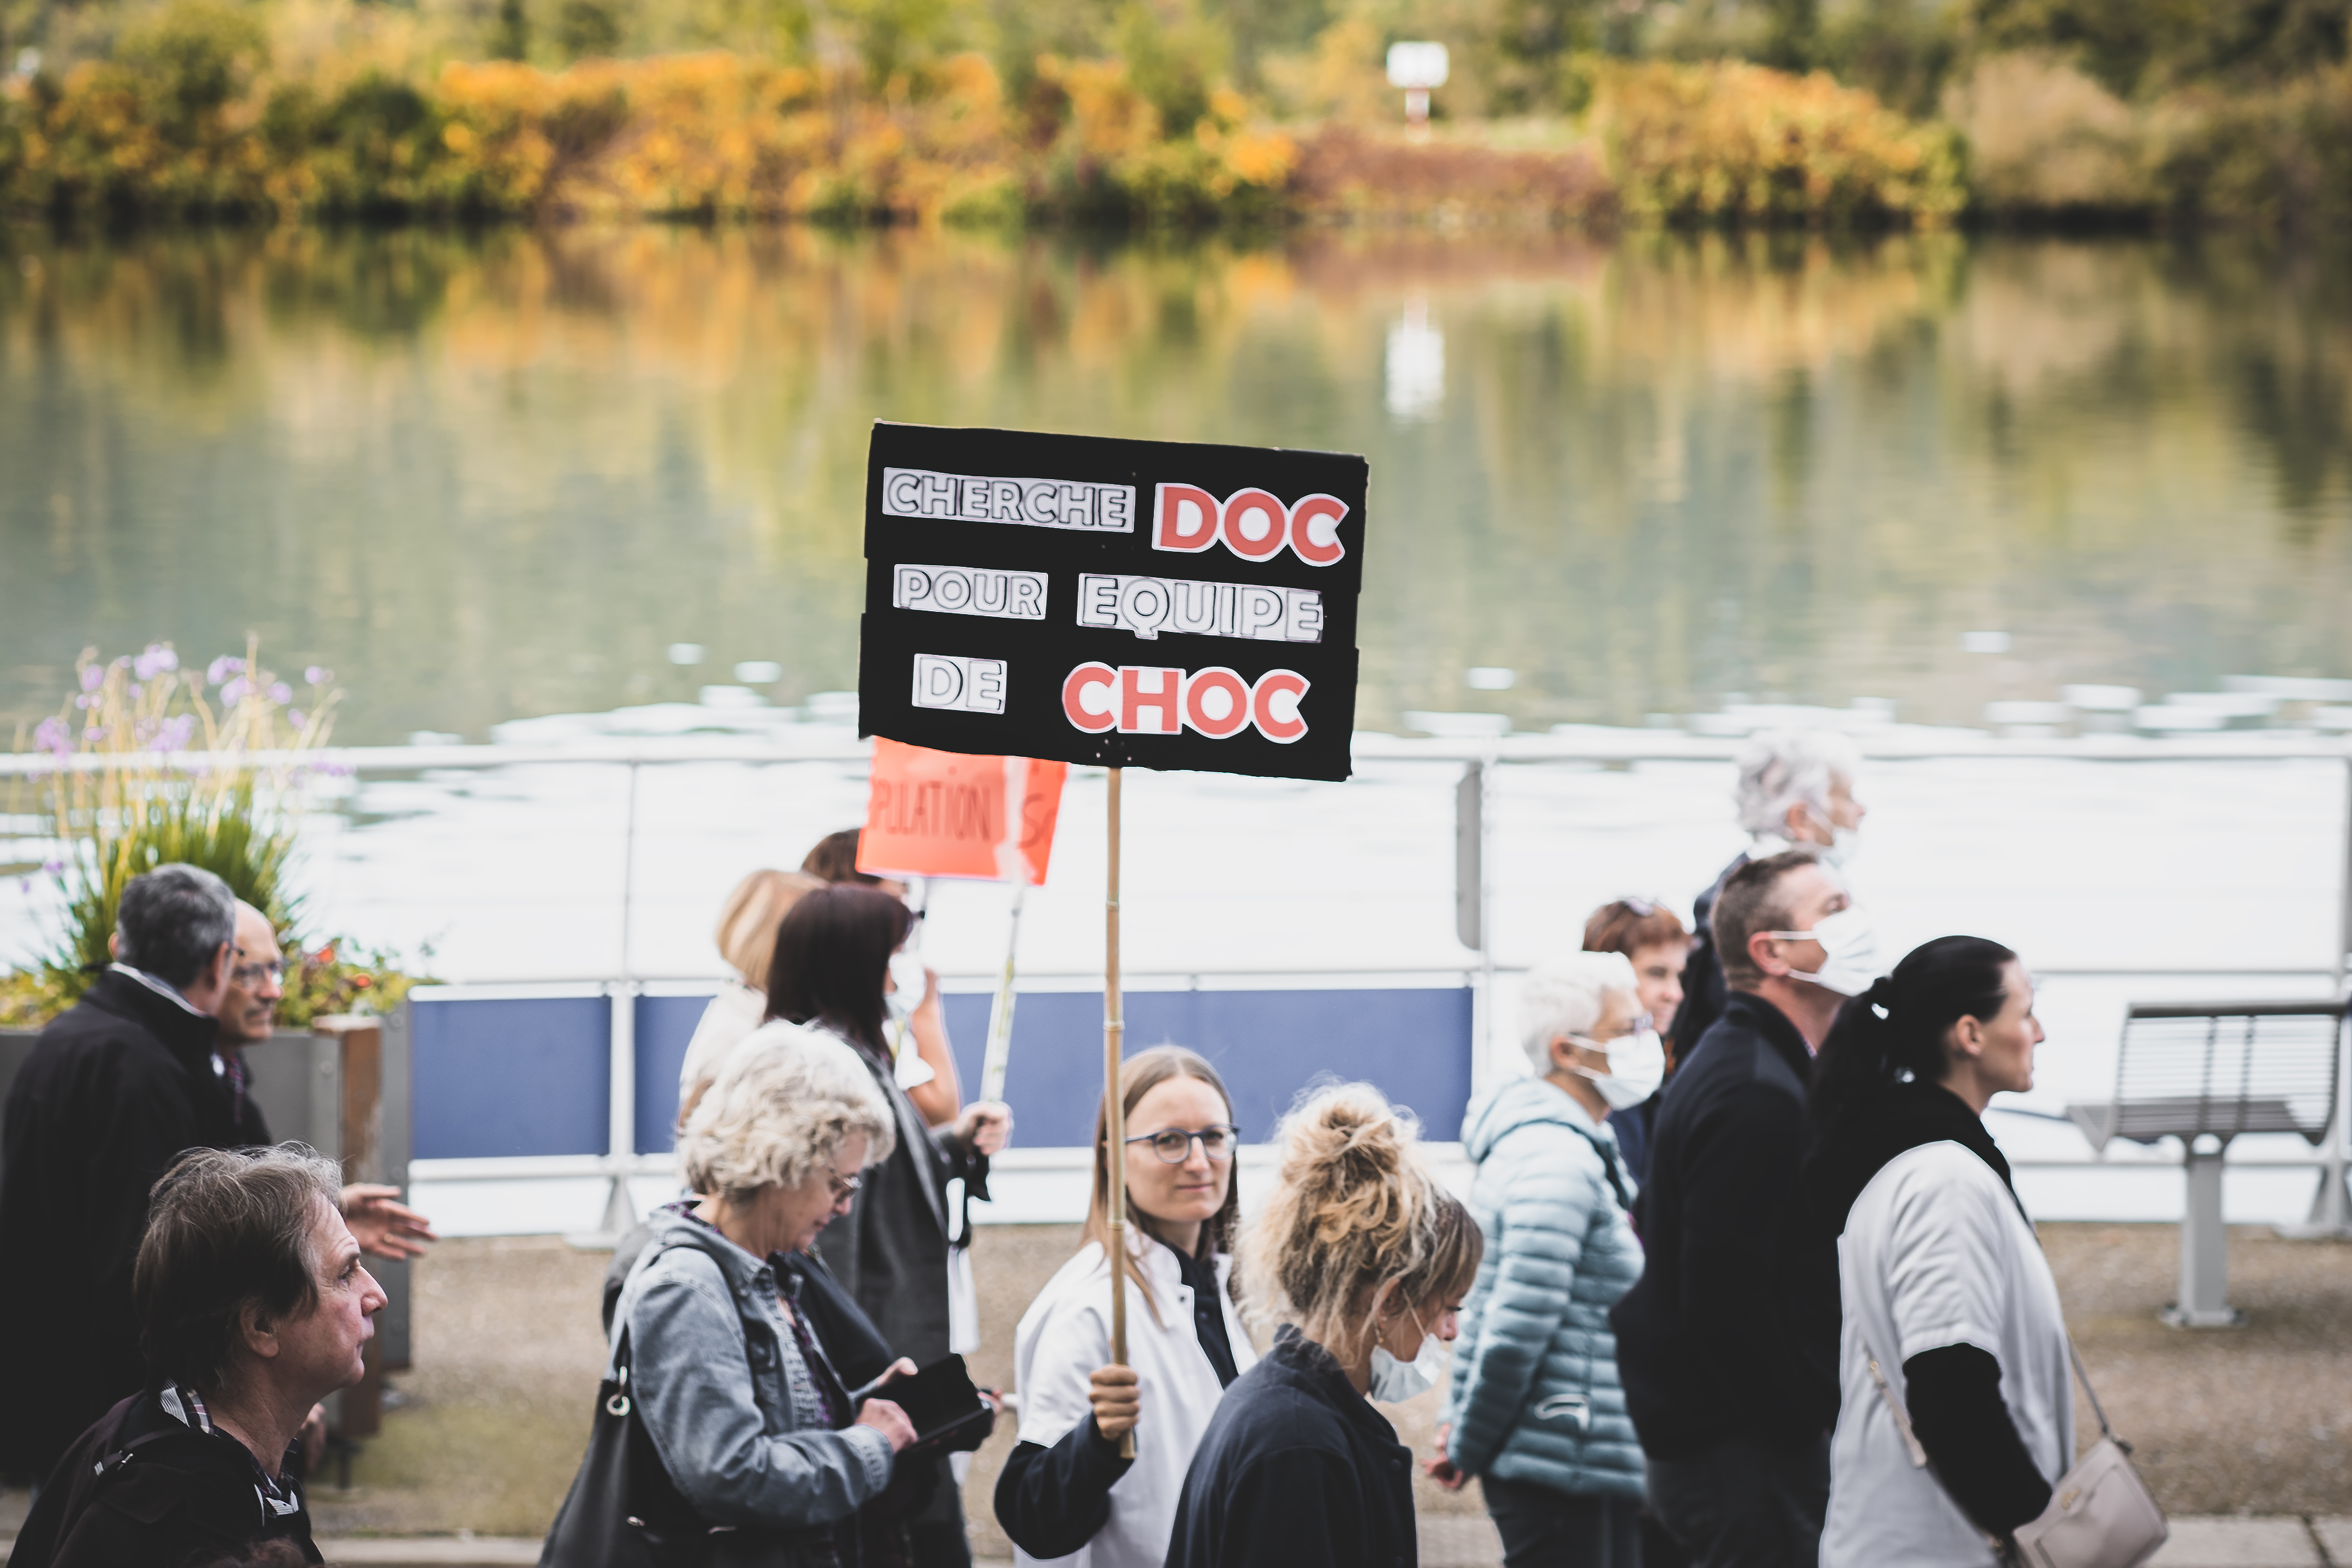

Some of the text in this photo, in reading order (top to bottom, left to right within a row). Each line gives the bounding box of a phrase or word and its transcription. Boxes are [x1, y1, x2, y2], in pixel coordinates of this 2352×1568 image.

[887, 472, 1346, 563] CHERCHE DOC
[898, 568, 1324, 641] POUR EQUIPE
[917, 657, 1309, 740] DE CHOC
